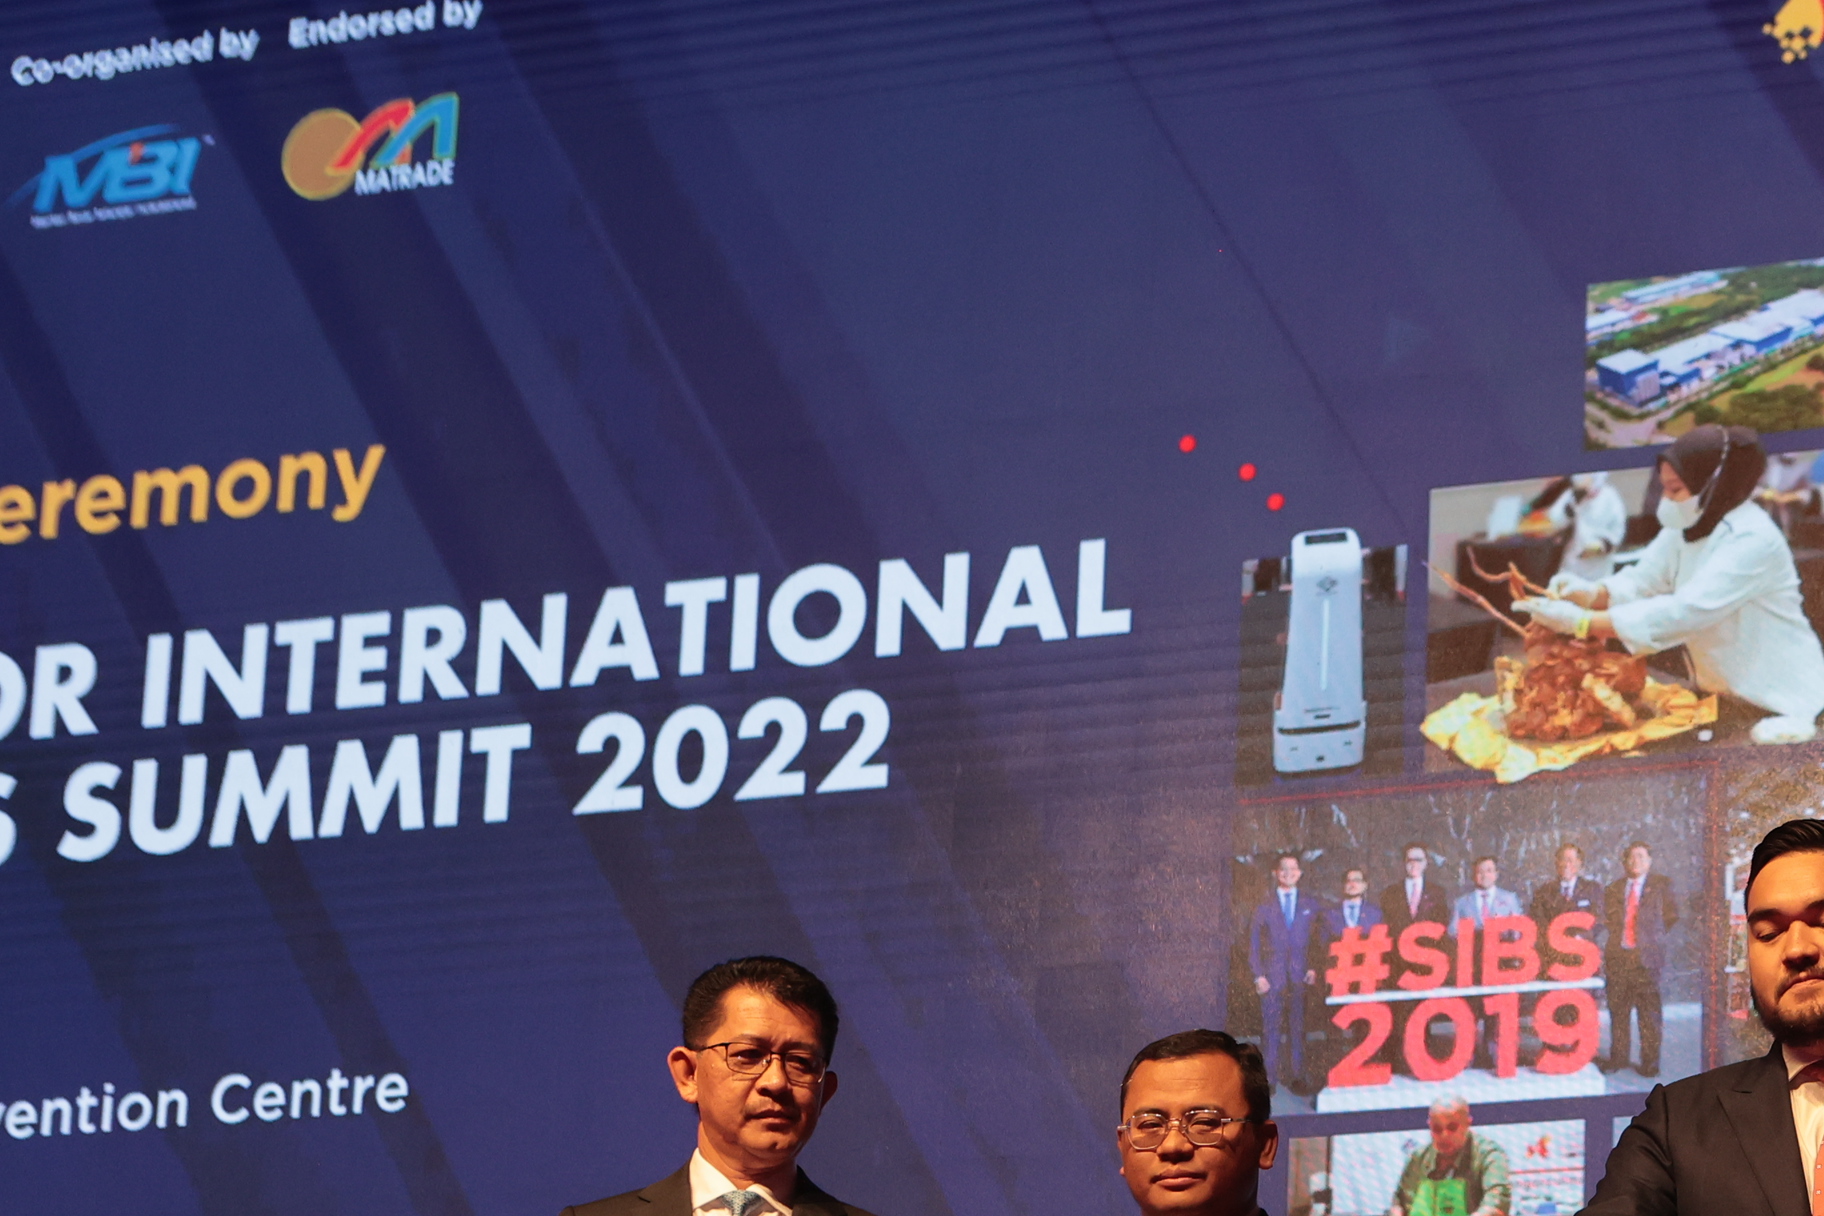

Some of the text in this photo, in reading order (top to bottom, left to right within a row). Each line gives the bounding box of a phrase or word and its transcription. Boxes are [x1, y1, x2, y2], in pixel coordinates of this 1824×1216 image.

[10, 26, 260, 87] Co-organised by
[288, 0, 483, 49] Endorsed by
[33, 136, 202, 213] MBI
[355, 159, 456, 195] MATRADE
[140, 538, 1133, 728] INTERNATIONAL
[57, 723, 532, 862] SUMMIT
[572, 688, 890, 815] 2022
[1325, 911, 1602, 996] #SIBS
[1328, 989, 1600, 1087] 2019
[0, 1068, 410, 1139] ention Centre
